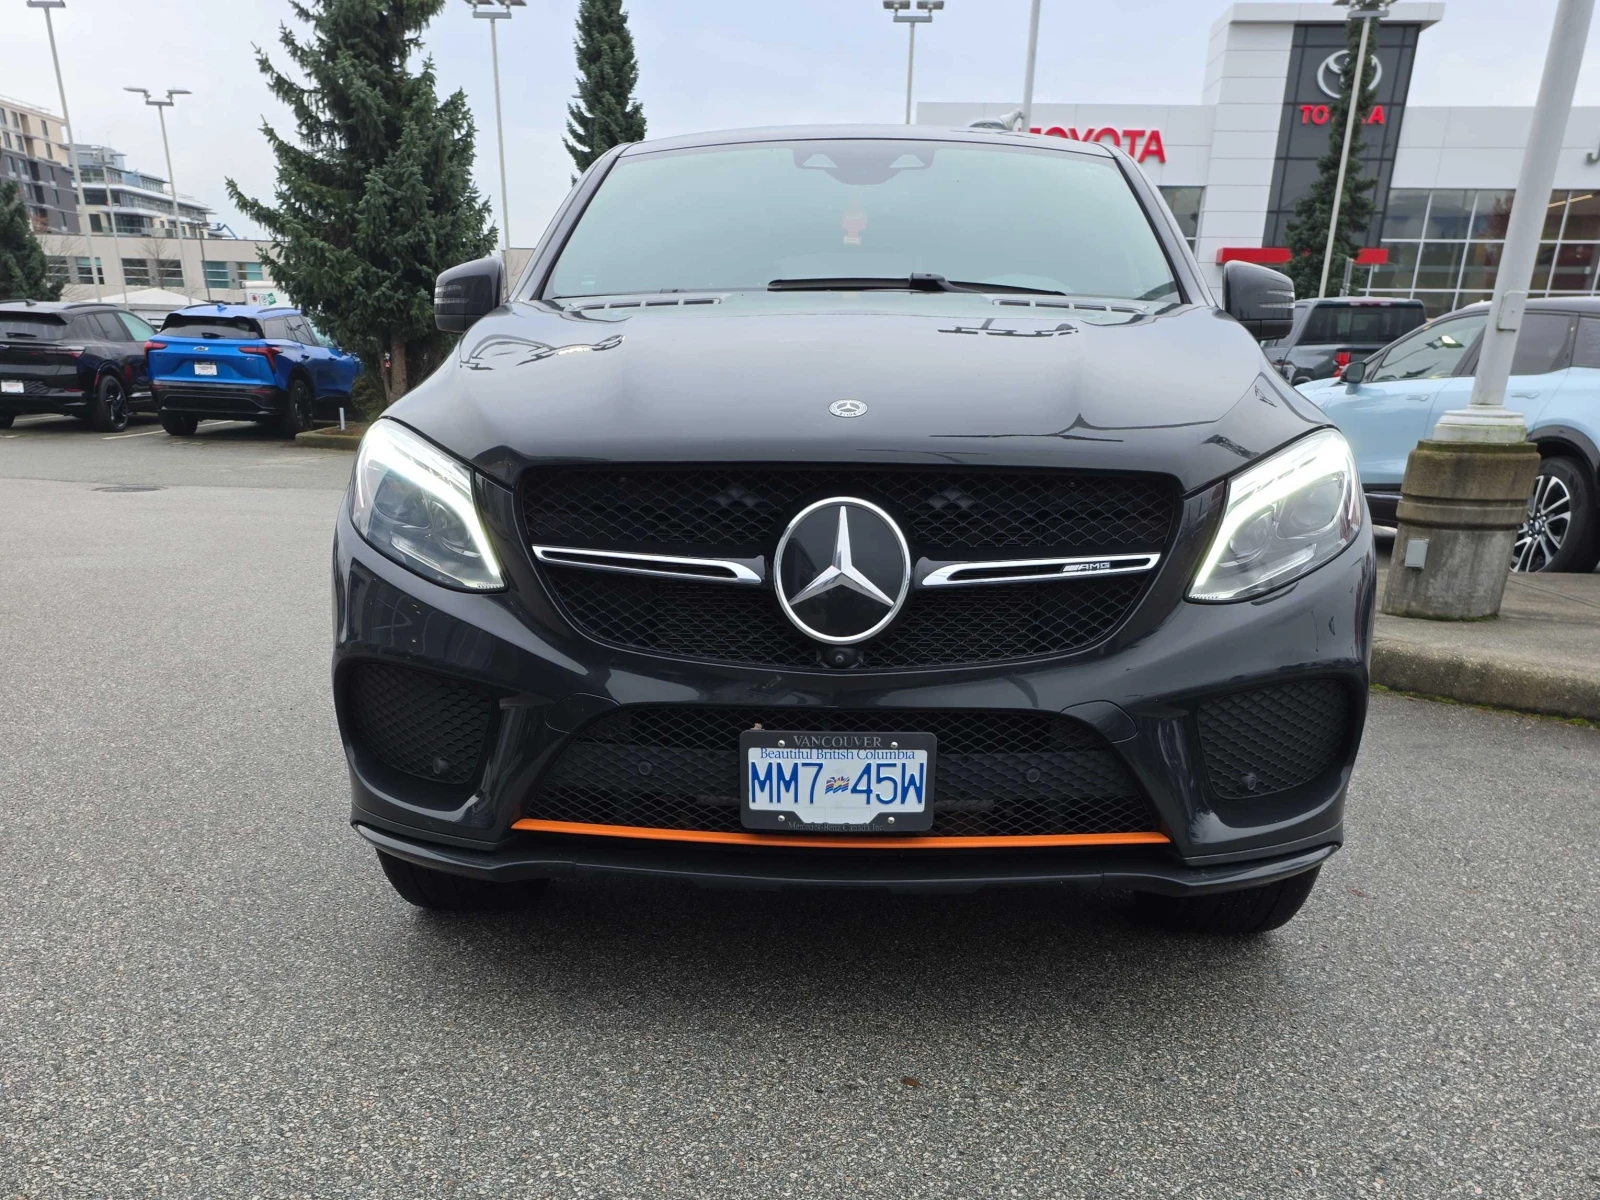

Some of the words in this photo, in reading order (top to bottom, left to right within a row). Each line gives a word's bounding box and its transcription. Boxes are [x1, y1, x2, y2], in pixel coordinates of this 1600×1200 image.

[1299, 104, 1386, 125] TOA
[1077, 561, 1111, 571] AMG
[793, 735, 882, 748] VANCOUVER
[760, 748, 813, 759] Beautiful
[816, 748, 854, 760] British
[856, 748, 915, 760] Columbia
[751, 762, 824, 804] MM7
[850, 762, 925, 805] 45W
